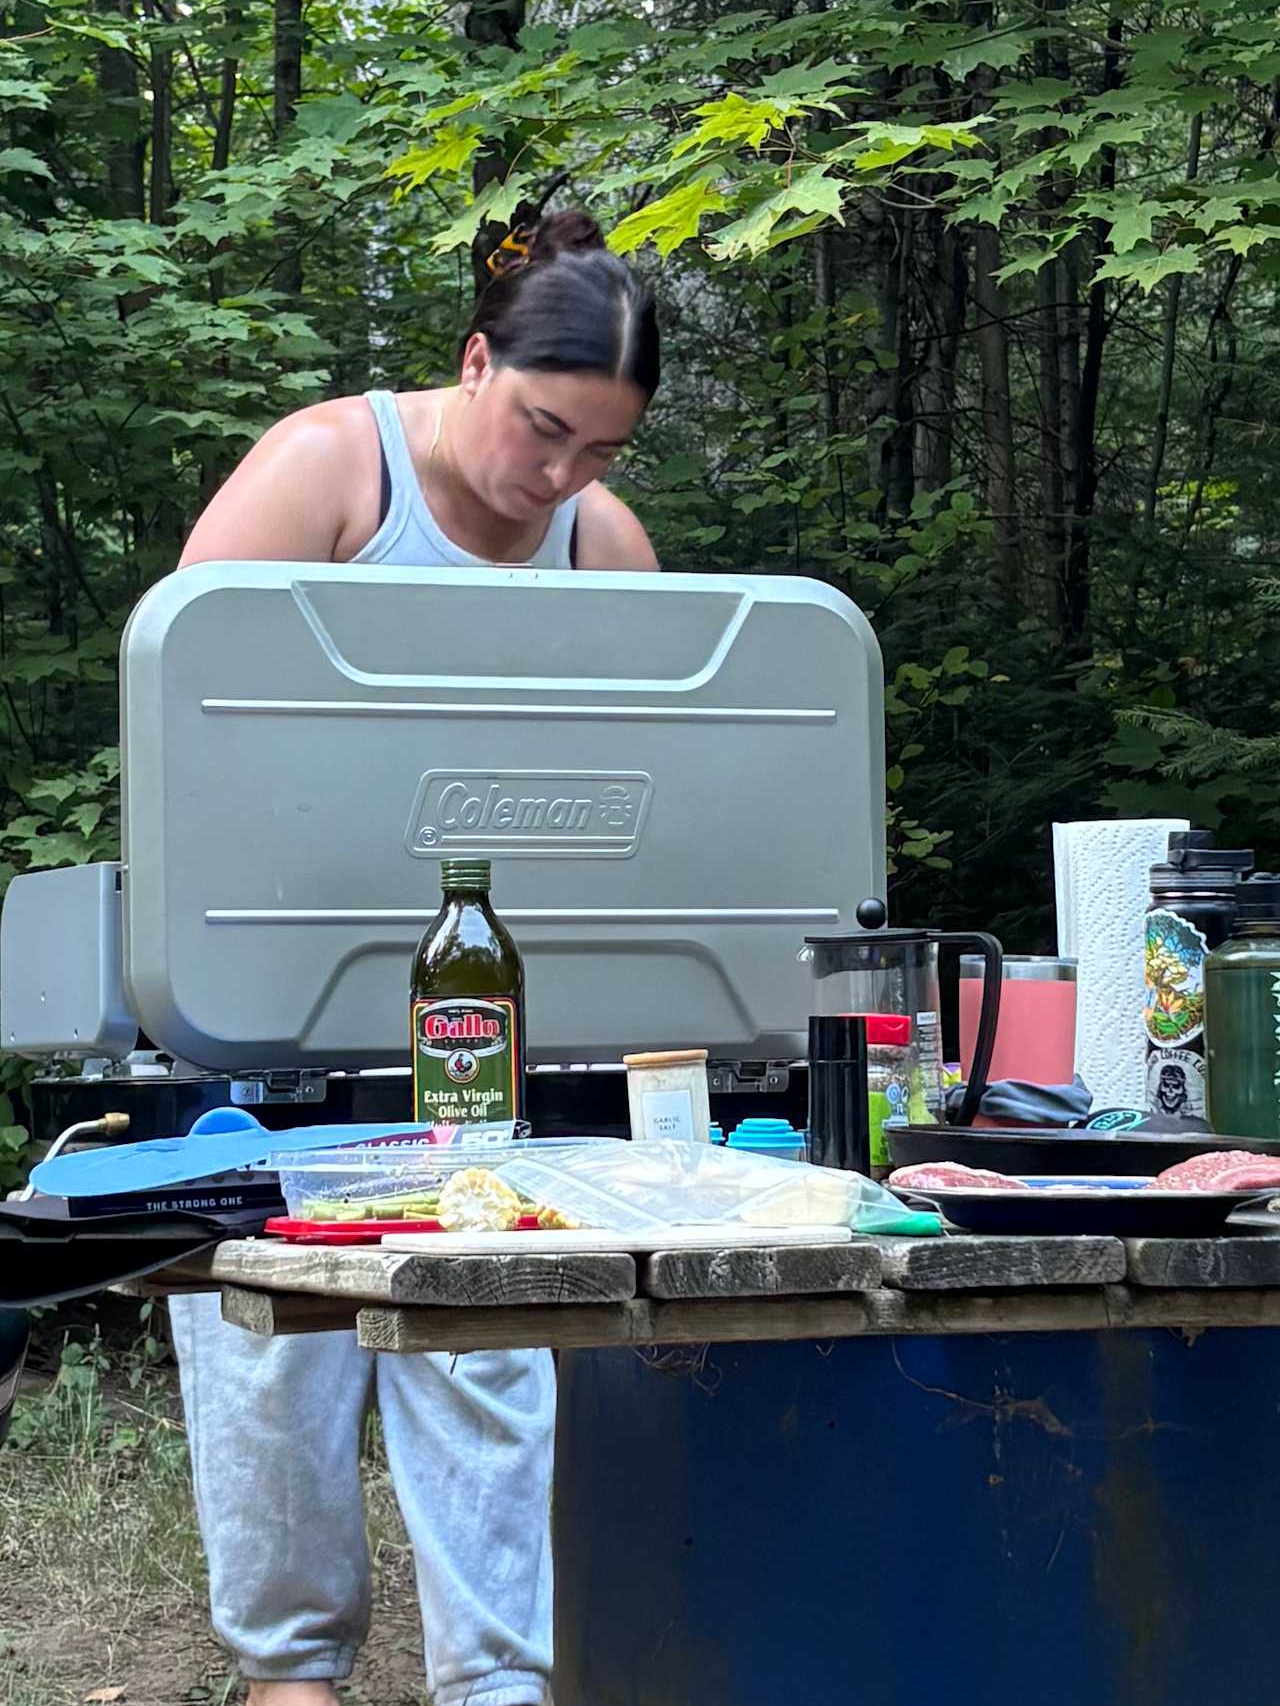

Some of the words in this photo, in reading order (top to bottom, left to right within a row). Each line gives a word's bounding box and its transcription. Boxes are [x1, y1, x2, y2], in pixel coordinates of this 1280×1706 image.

[437, 781, 593, 830] Coleman
[425, 1013, 500, 1039] Gallo
[1160, 1048, 1191, 1062] COFFEE
[423, 1090, 458, 1104] Extra
[462, 1088, 504, 1105] Virgin
[438, 1104, 468, 1119] Olive
[470, 1103, 488, 1117] Oil
[146, 1201, 168, 1212] THE
[171, 1197, 217, 1210] STRONG
[219, 1195, 243, 1207] ONE
